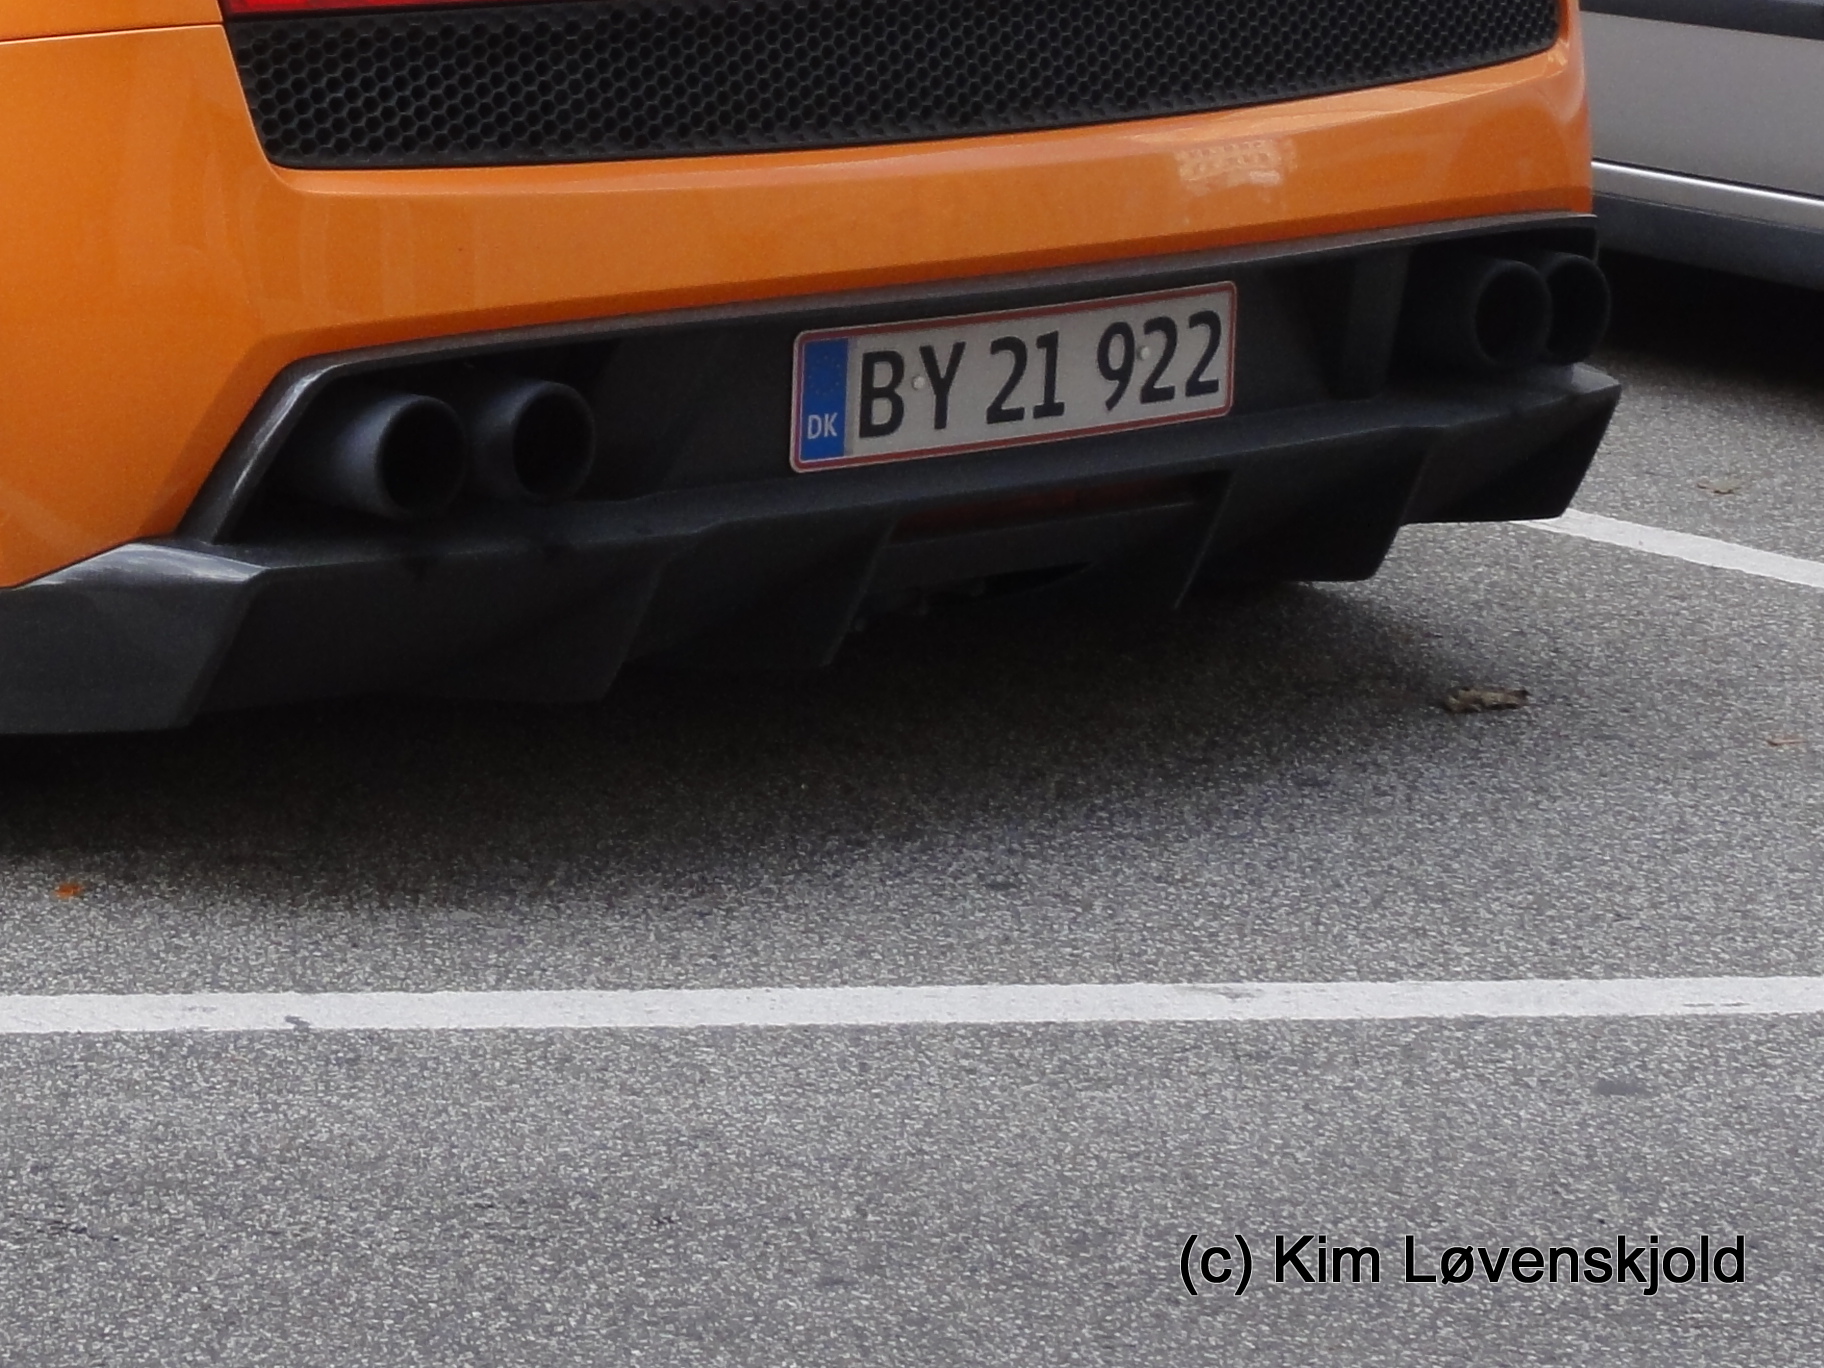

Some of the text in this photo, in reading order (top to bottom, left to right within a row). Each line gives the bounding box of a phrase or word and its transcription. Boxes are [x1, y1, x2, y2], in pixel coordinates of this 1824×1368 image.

[858, 309, 1223, 439] BY 21 922
[807, 412, 839, 440] DK
